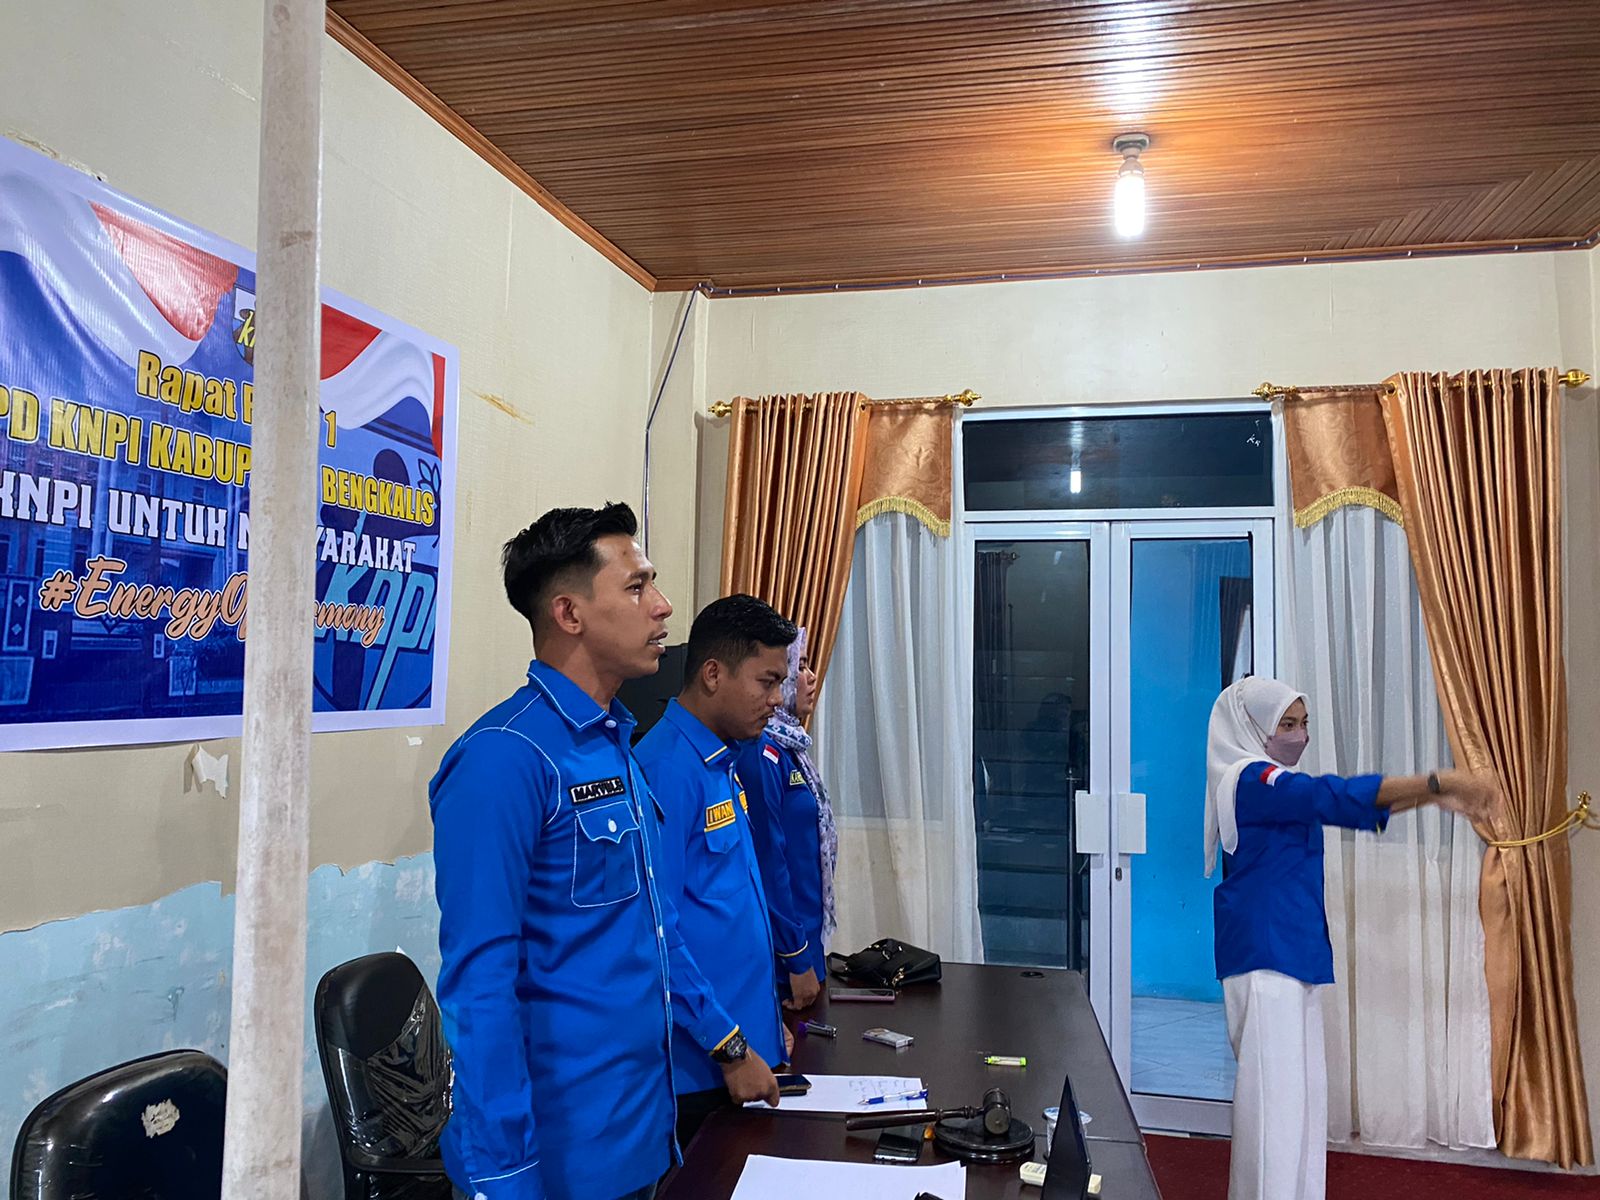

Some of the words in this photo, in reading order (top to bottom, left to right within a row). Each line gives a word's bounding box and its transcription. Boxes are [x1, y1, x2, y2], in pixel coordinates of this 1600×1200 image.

[137, 350, 237, 420] Rapat
[322, 410, 337, 448] 1
[50, 397, 142, 464] KNPI
[147, 421, 252, 488] KABUP
[321, 465, 435, 526] BENGKALIS
[108, 488, 228, 547] UNTUK
